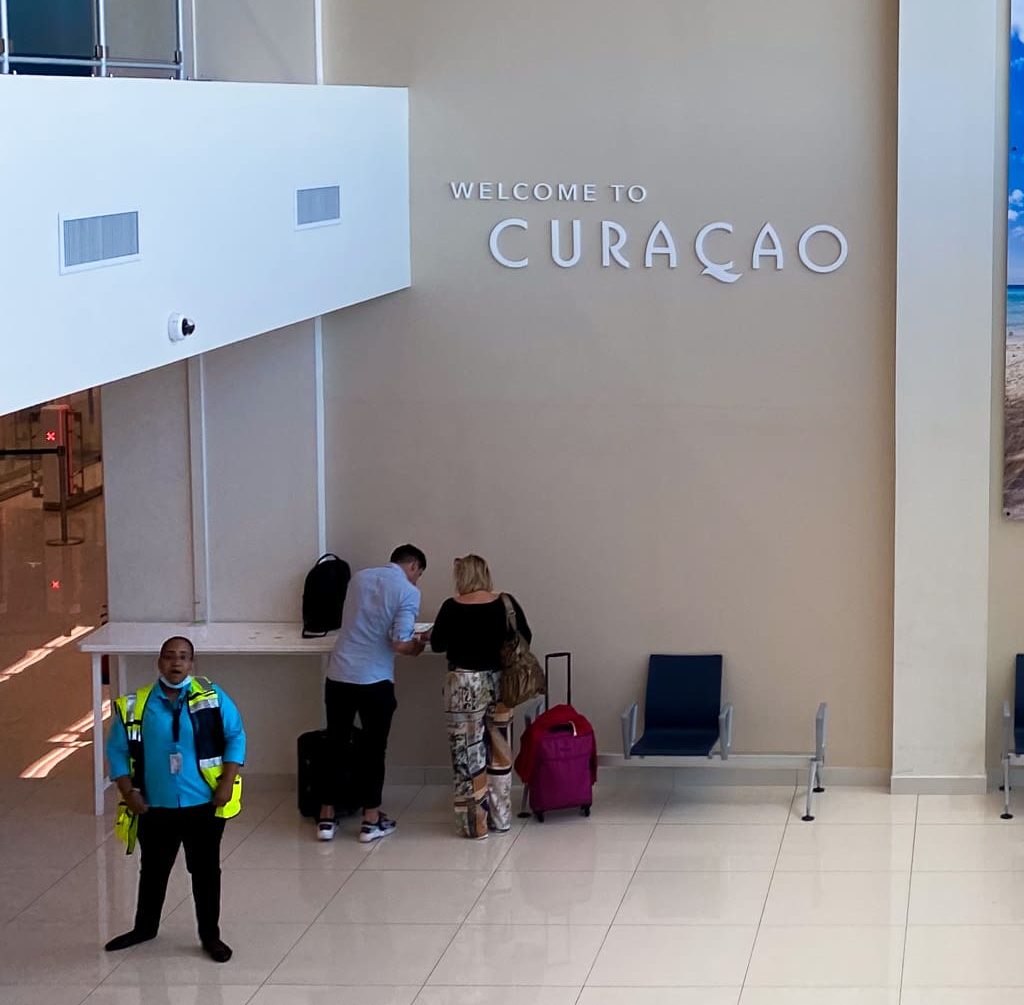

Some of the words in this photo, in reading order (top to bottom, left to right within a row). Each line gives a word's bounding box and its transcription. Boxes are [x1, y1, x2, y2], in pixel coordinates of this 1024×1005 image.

[450, 181, 597, 202] WELCOME
[610, 184, 647, 203] TO
[489, 218, 848, 283] CURAÇAO
